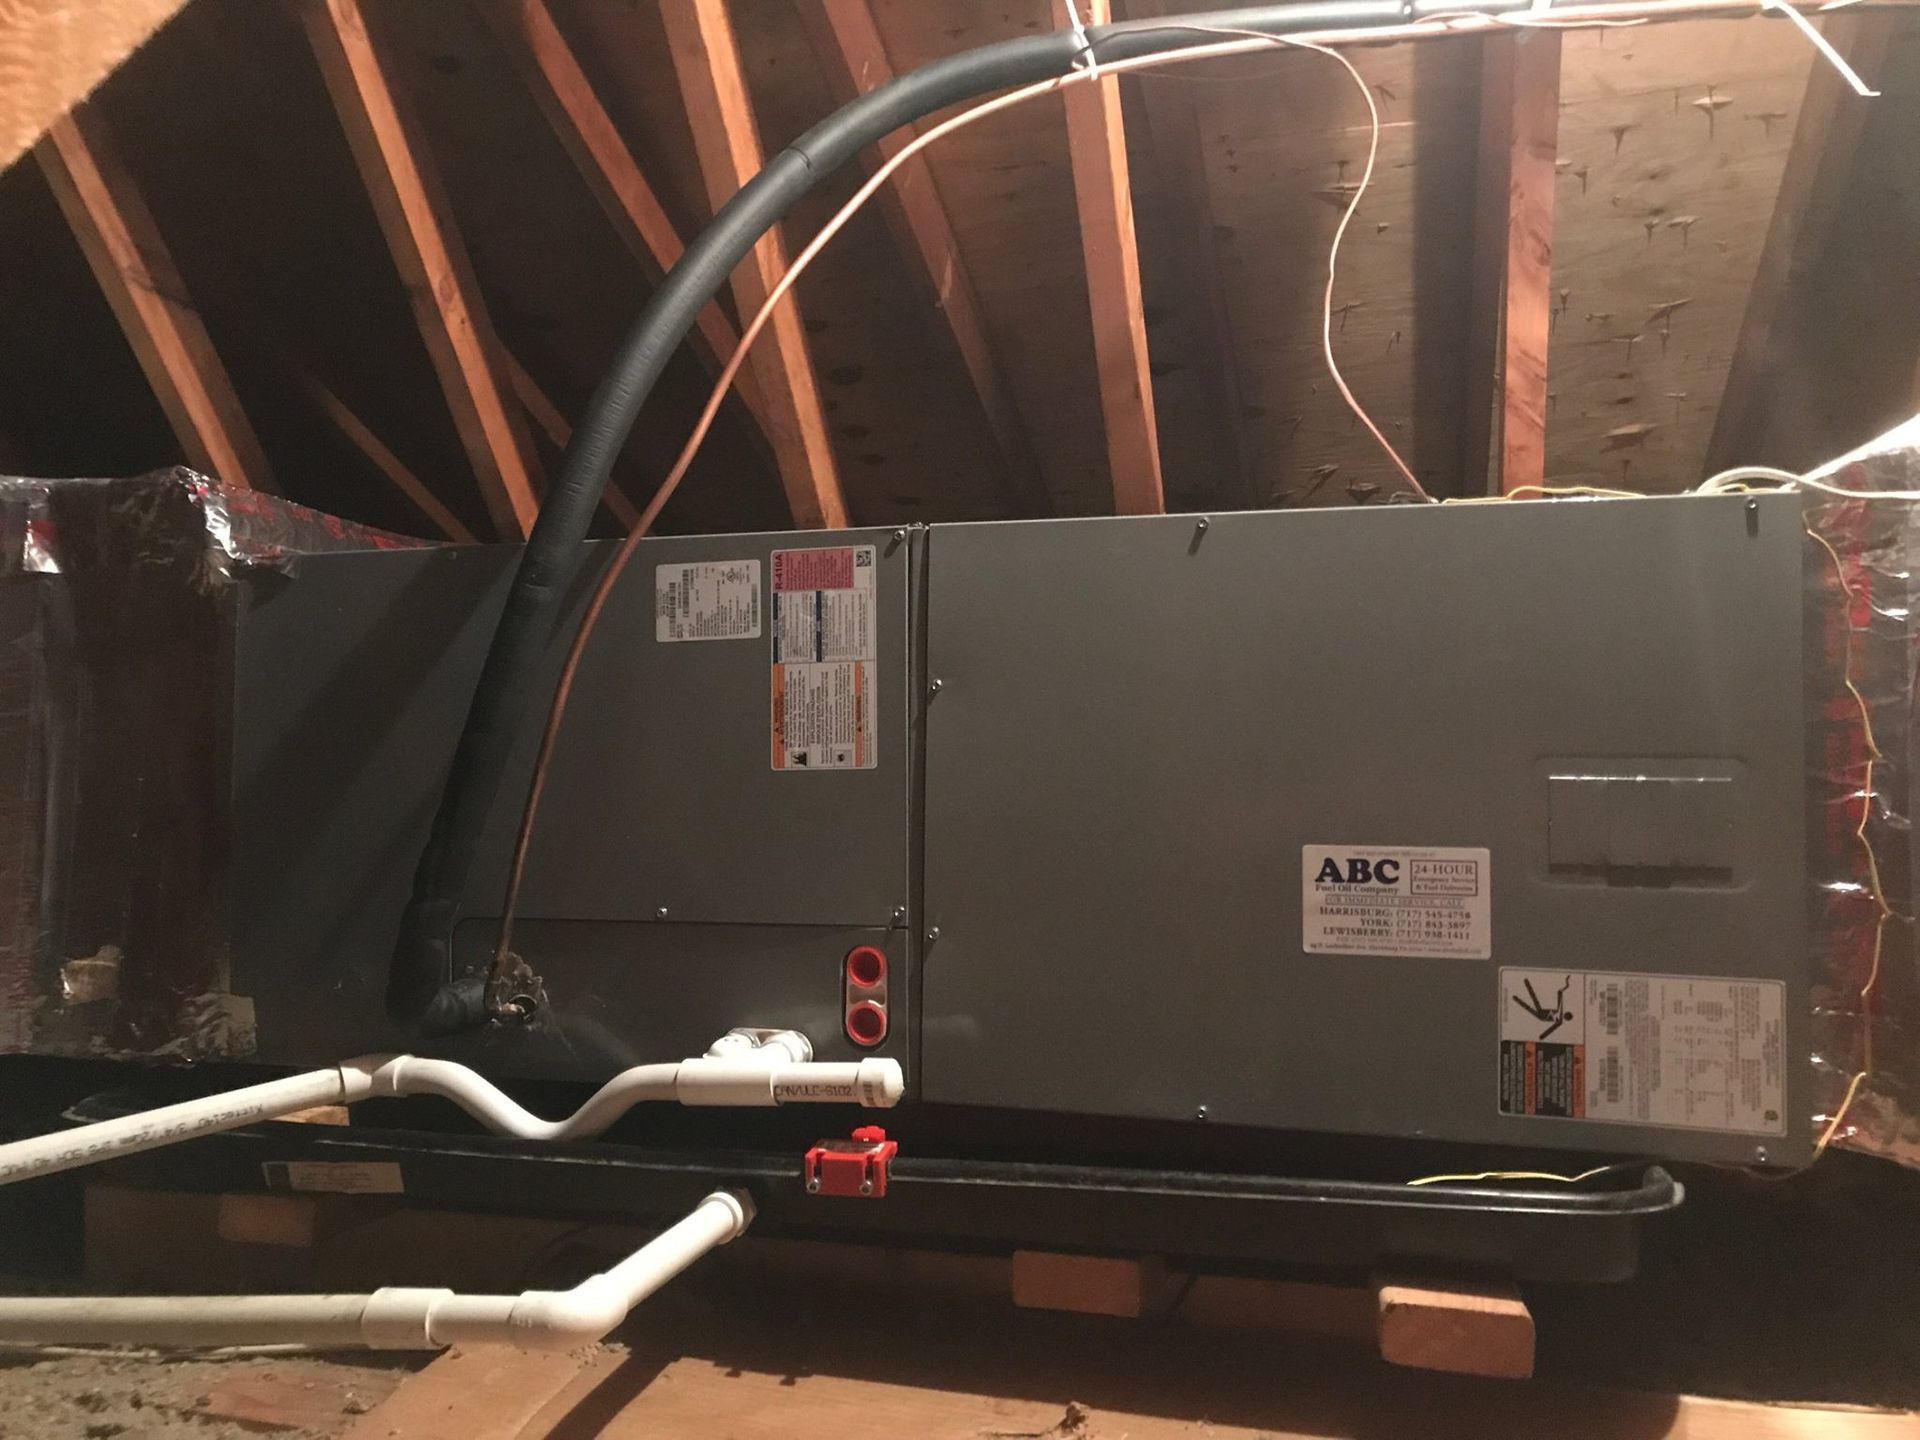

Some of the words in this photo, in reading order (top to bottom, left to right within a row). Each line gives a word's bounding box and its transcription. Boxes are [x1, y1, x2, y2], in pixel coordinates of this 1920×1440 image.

[775, 554, 783, 590] R-410A
[1315, 858, 1400, 884] ABC
[1315, 884, 1335, 892] Fuel
[1338, 884, 1352, 892] Oil
[1354, 885, 1399, 895] Company
[1320, 906, 1393, 917] HARRISBURG:
[1396, 908, 1421, 919] (717)
[1360, 918, 1393, 927] YORK:
[1396, 919, 1421, 929] (717)
[1323, 927, 1393, 937] LEWISBERRY:
[1396, 928, 1422, 938] (717)
